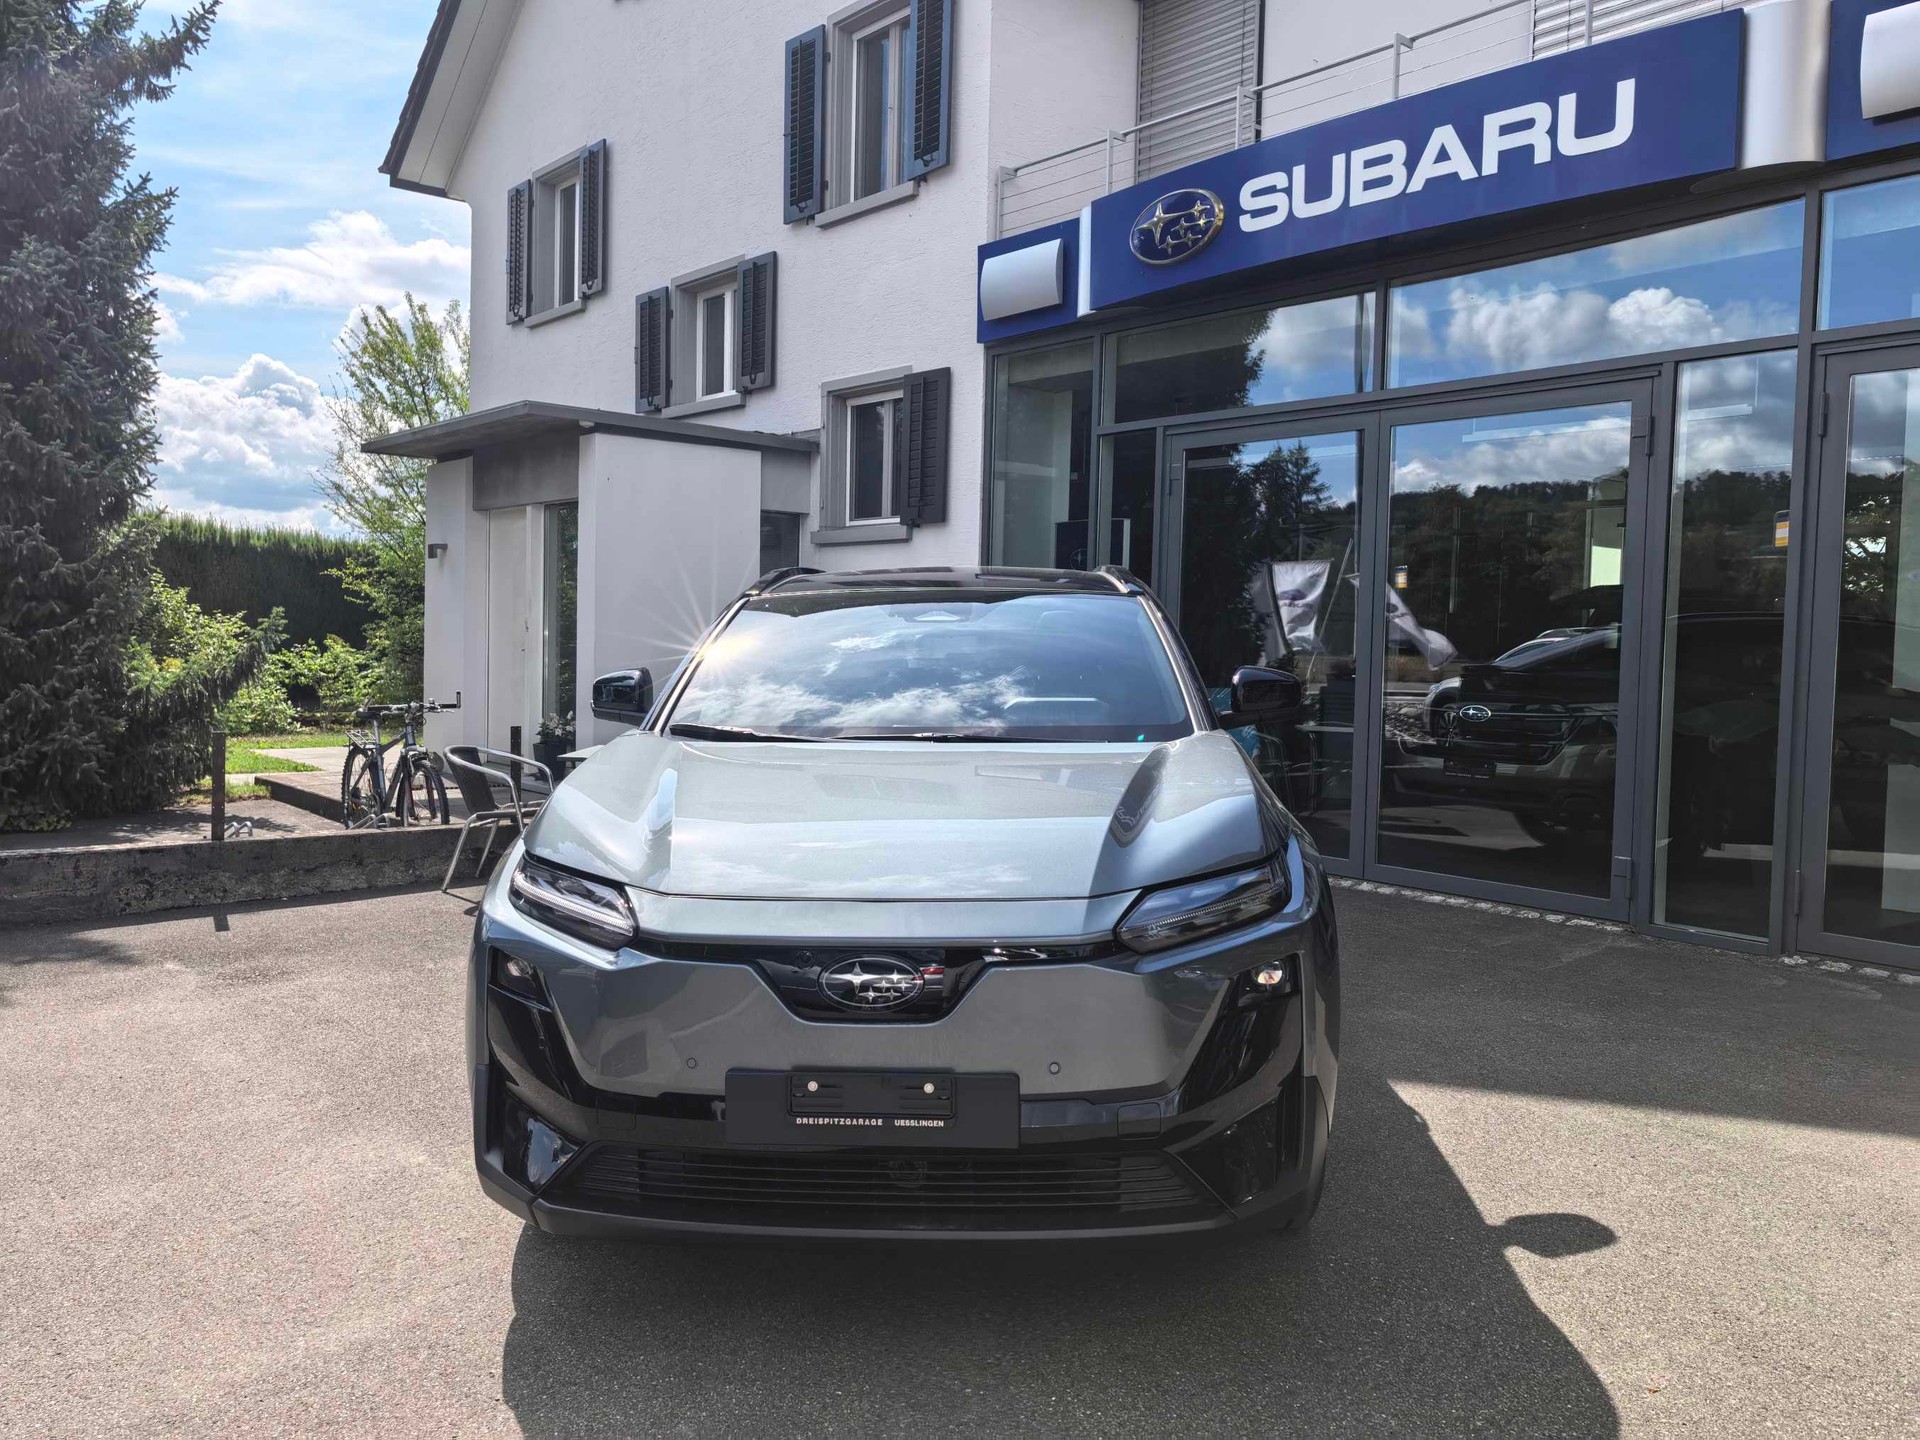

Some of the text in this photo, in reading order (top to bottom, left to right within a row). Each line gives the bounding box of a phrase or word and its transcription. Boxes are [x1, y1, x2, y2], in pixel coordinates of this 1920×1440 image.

[1238, 78, 1636, 233] SUBARU
[796, 1117, 945, 1128] DREISPITZGARAGE UESSLINGEN
